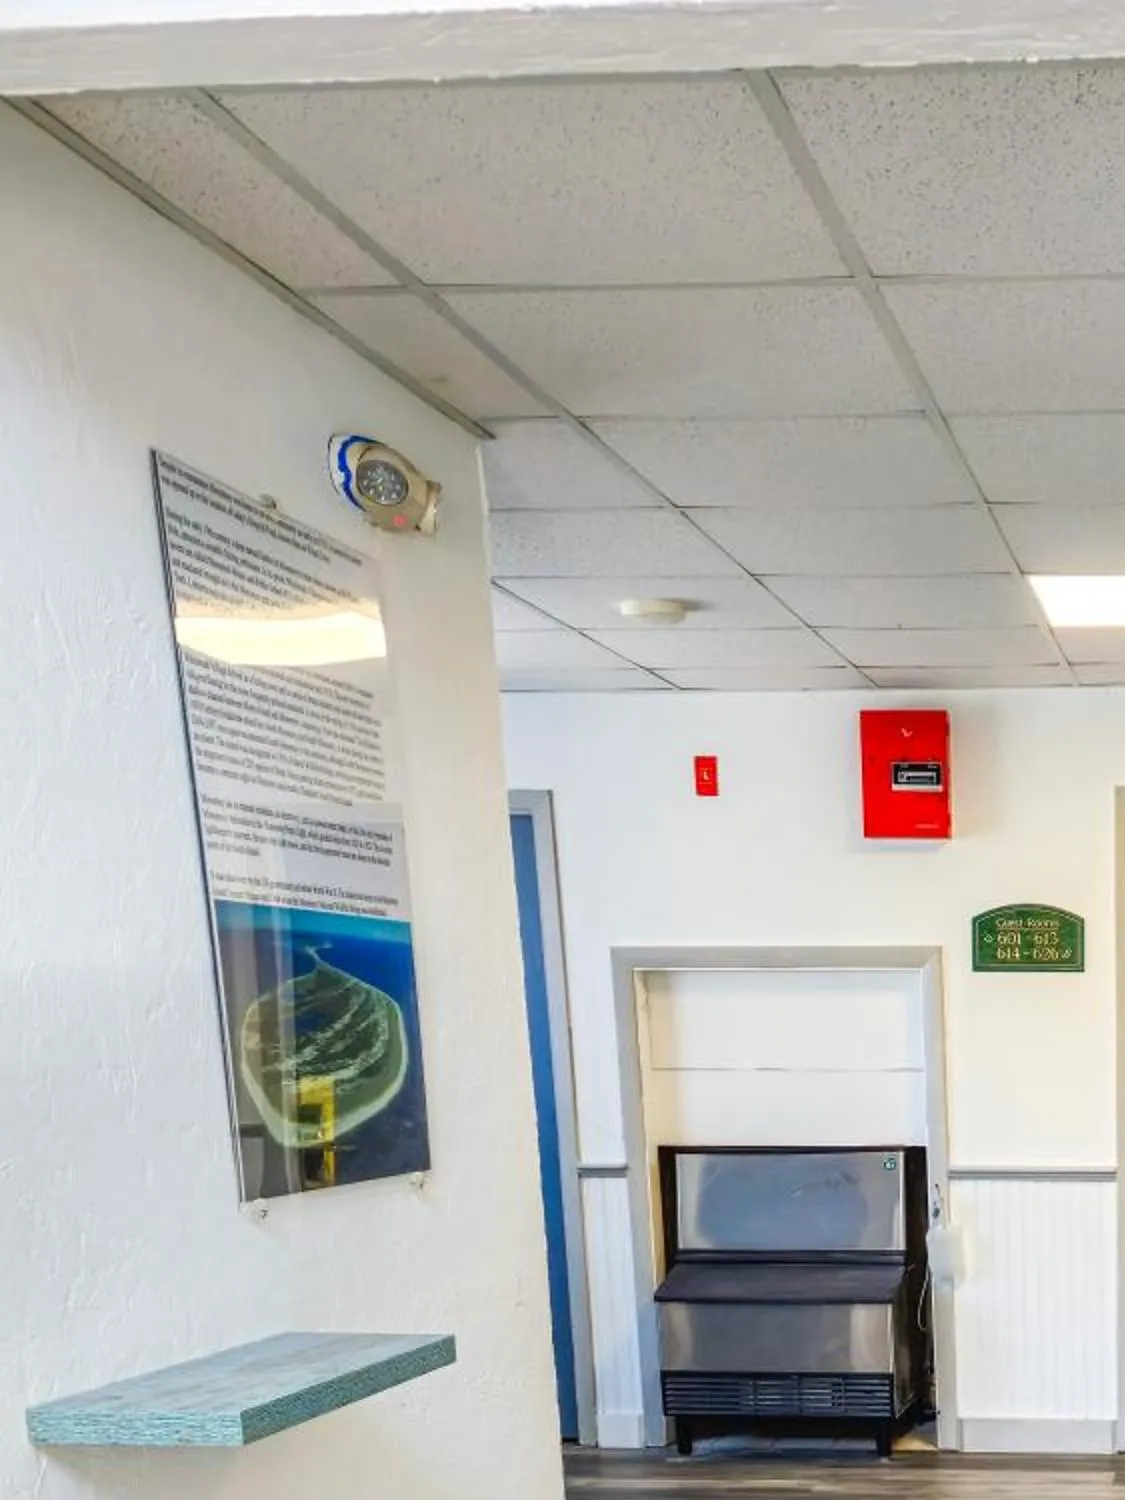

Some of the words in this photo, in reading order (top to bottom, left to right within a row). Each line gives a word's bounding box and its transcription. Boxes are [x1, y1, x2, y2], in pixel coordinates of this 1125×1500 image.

[995, 917, 1023, 929] Guest
[997, 931, 1021, 945] 601
[1034, 931, 1060, 945] 613
[997, 946, 1020, 960] 614
